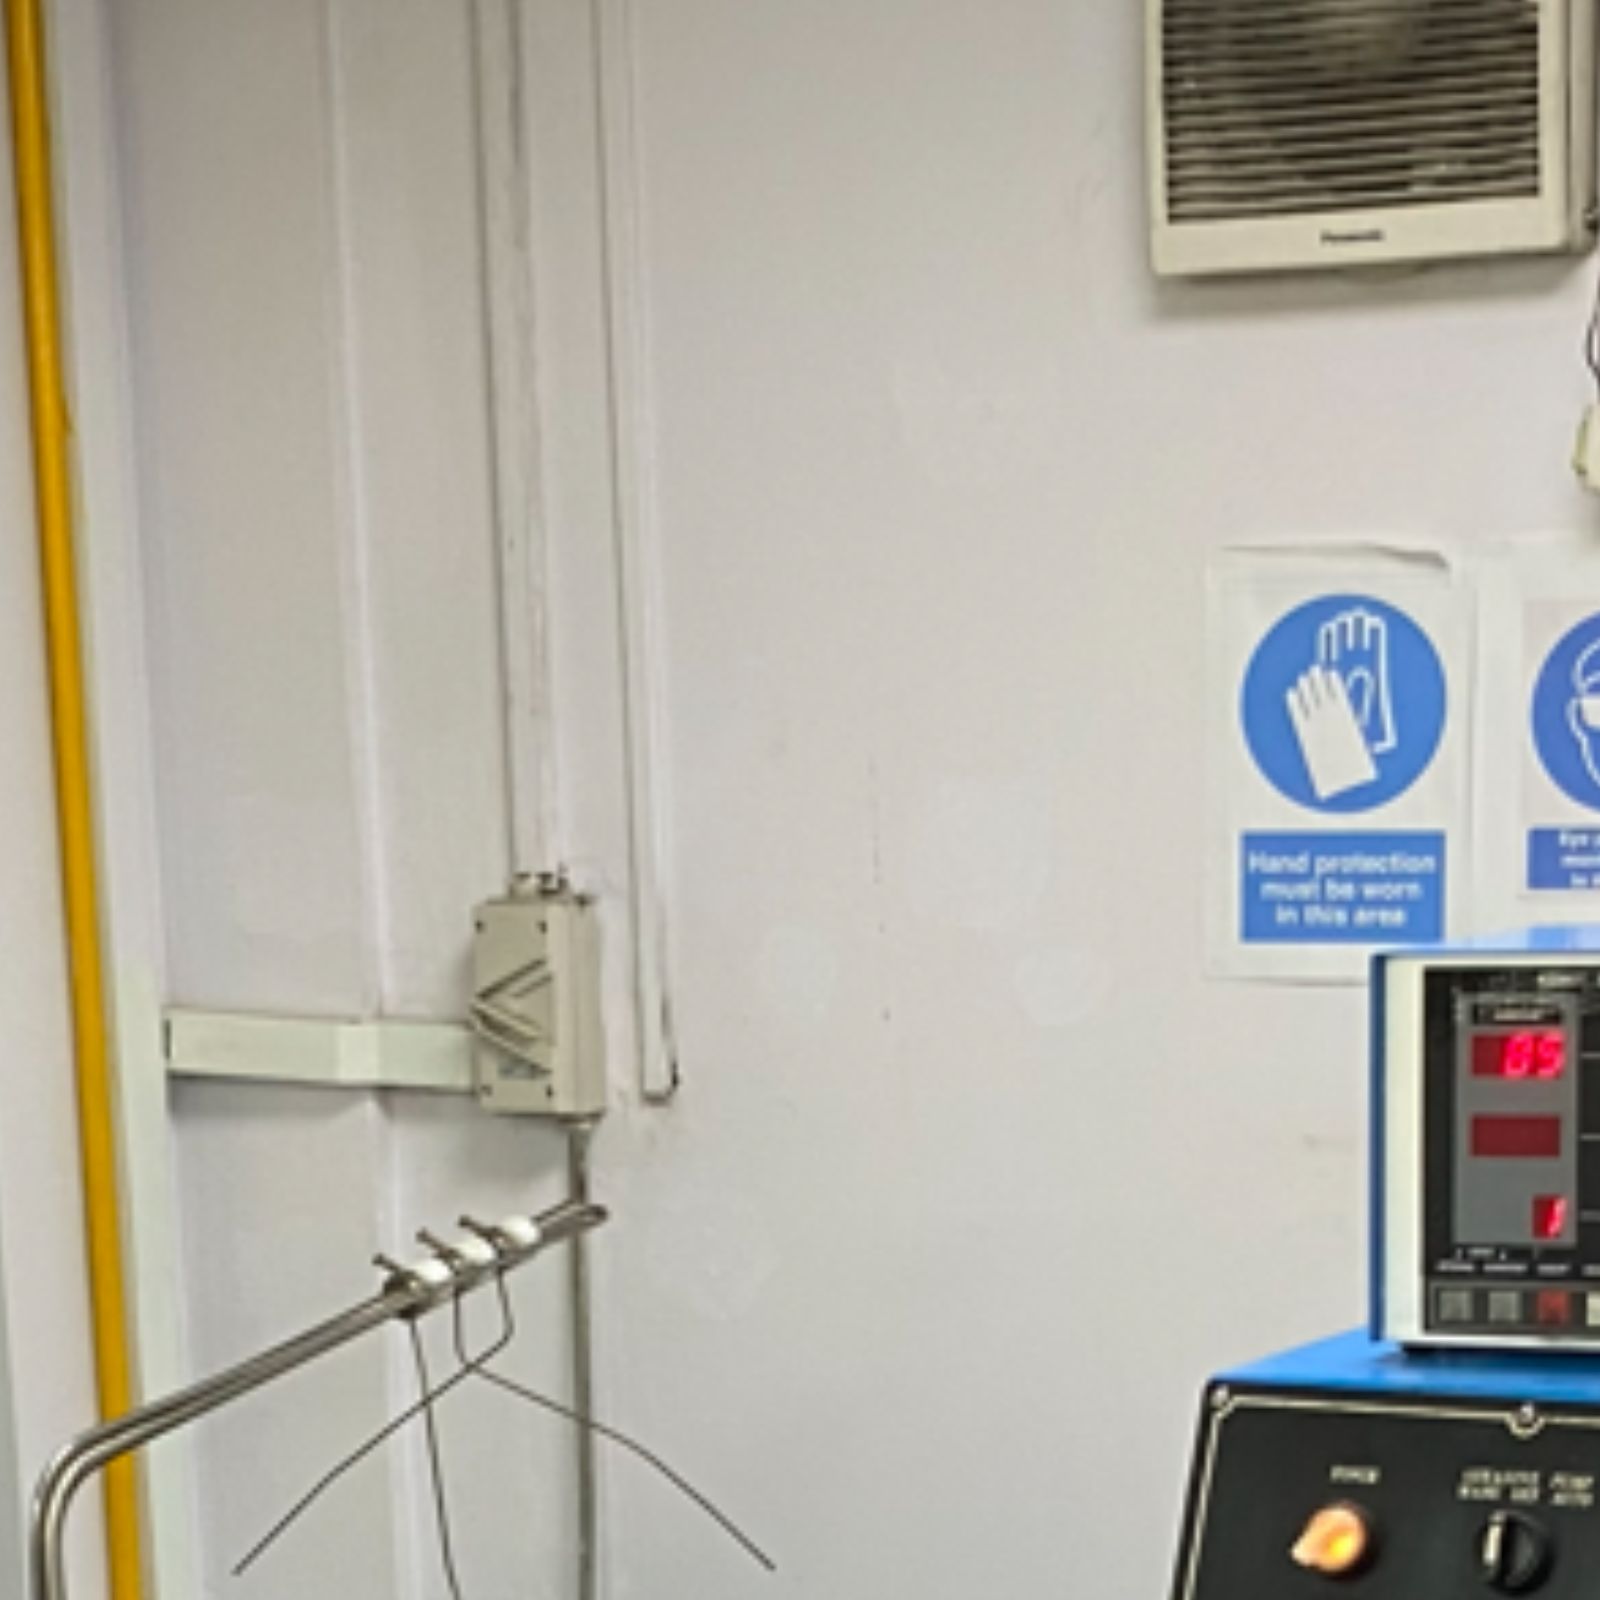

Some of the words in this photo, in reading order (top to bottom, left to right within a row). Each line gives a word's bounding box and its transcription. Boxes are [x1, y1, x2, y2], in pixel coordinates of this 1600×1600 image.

[1248, 850, 1310, 875] Hand
[1313, 850, 1437, 881] protection
[1260, 880, 1321, 902] must
[1325, 877, 1354, 901] be
[1362, 882, 1422, 901] worn
[1302, 902, 1348, 927] this
[1352, 907, 1407, 927] area
